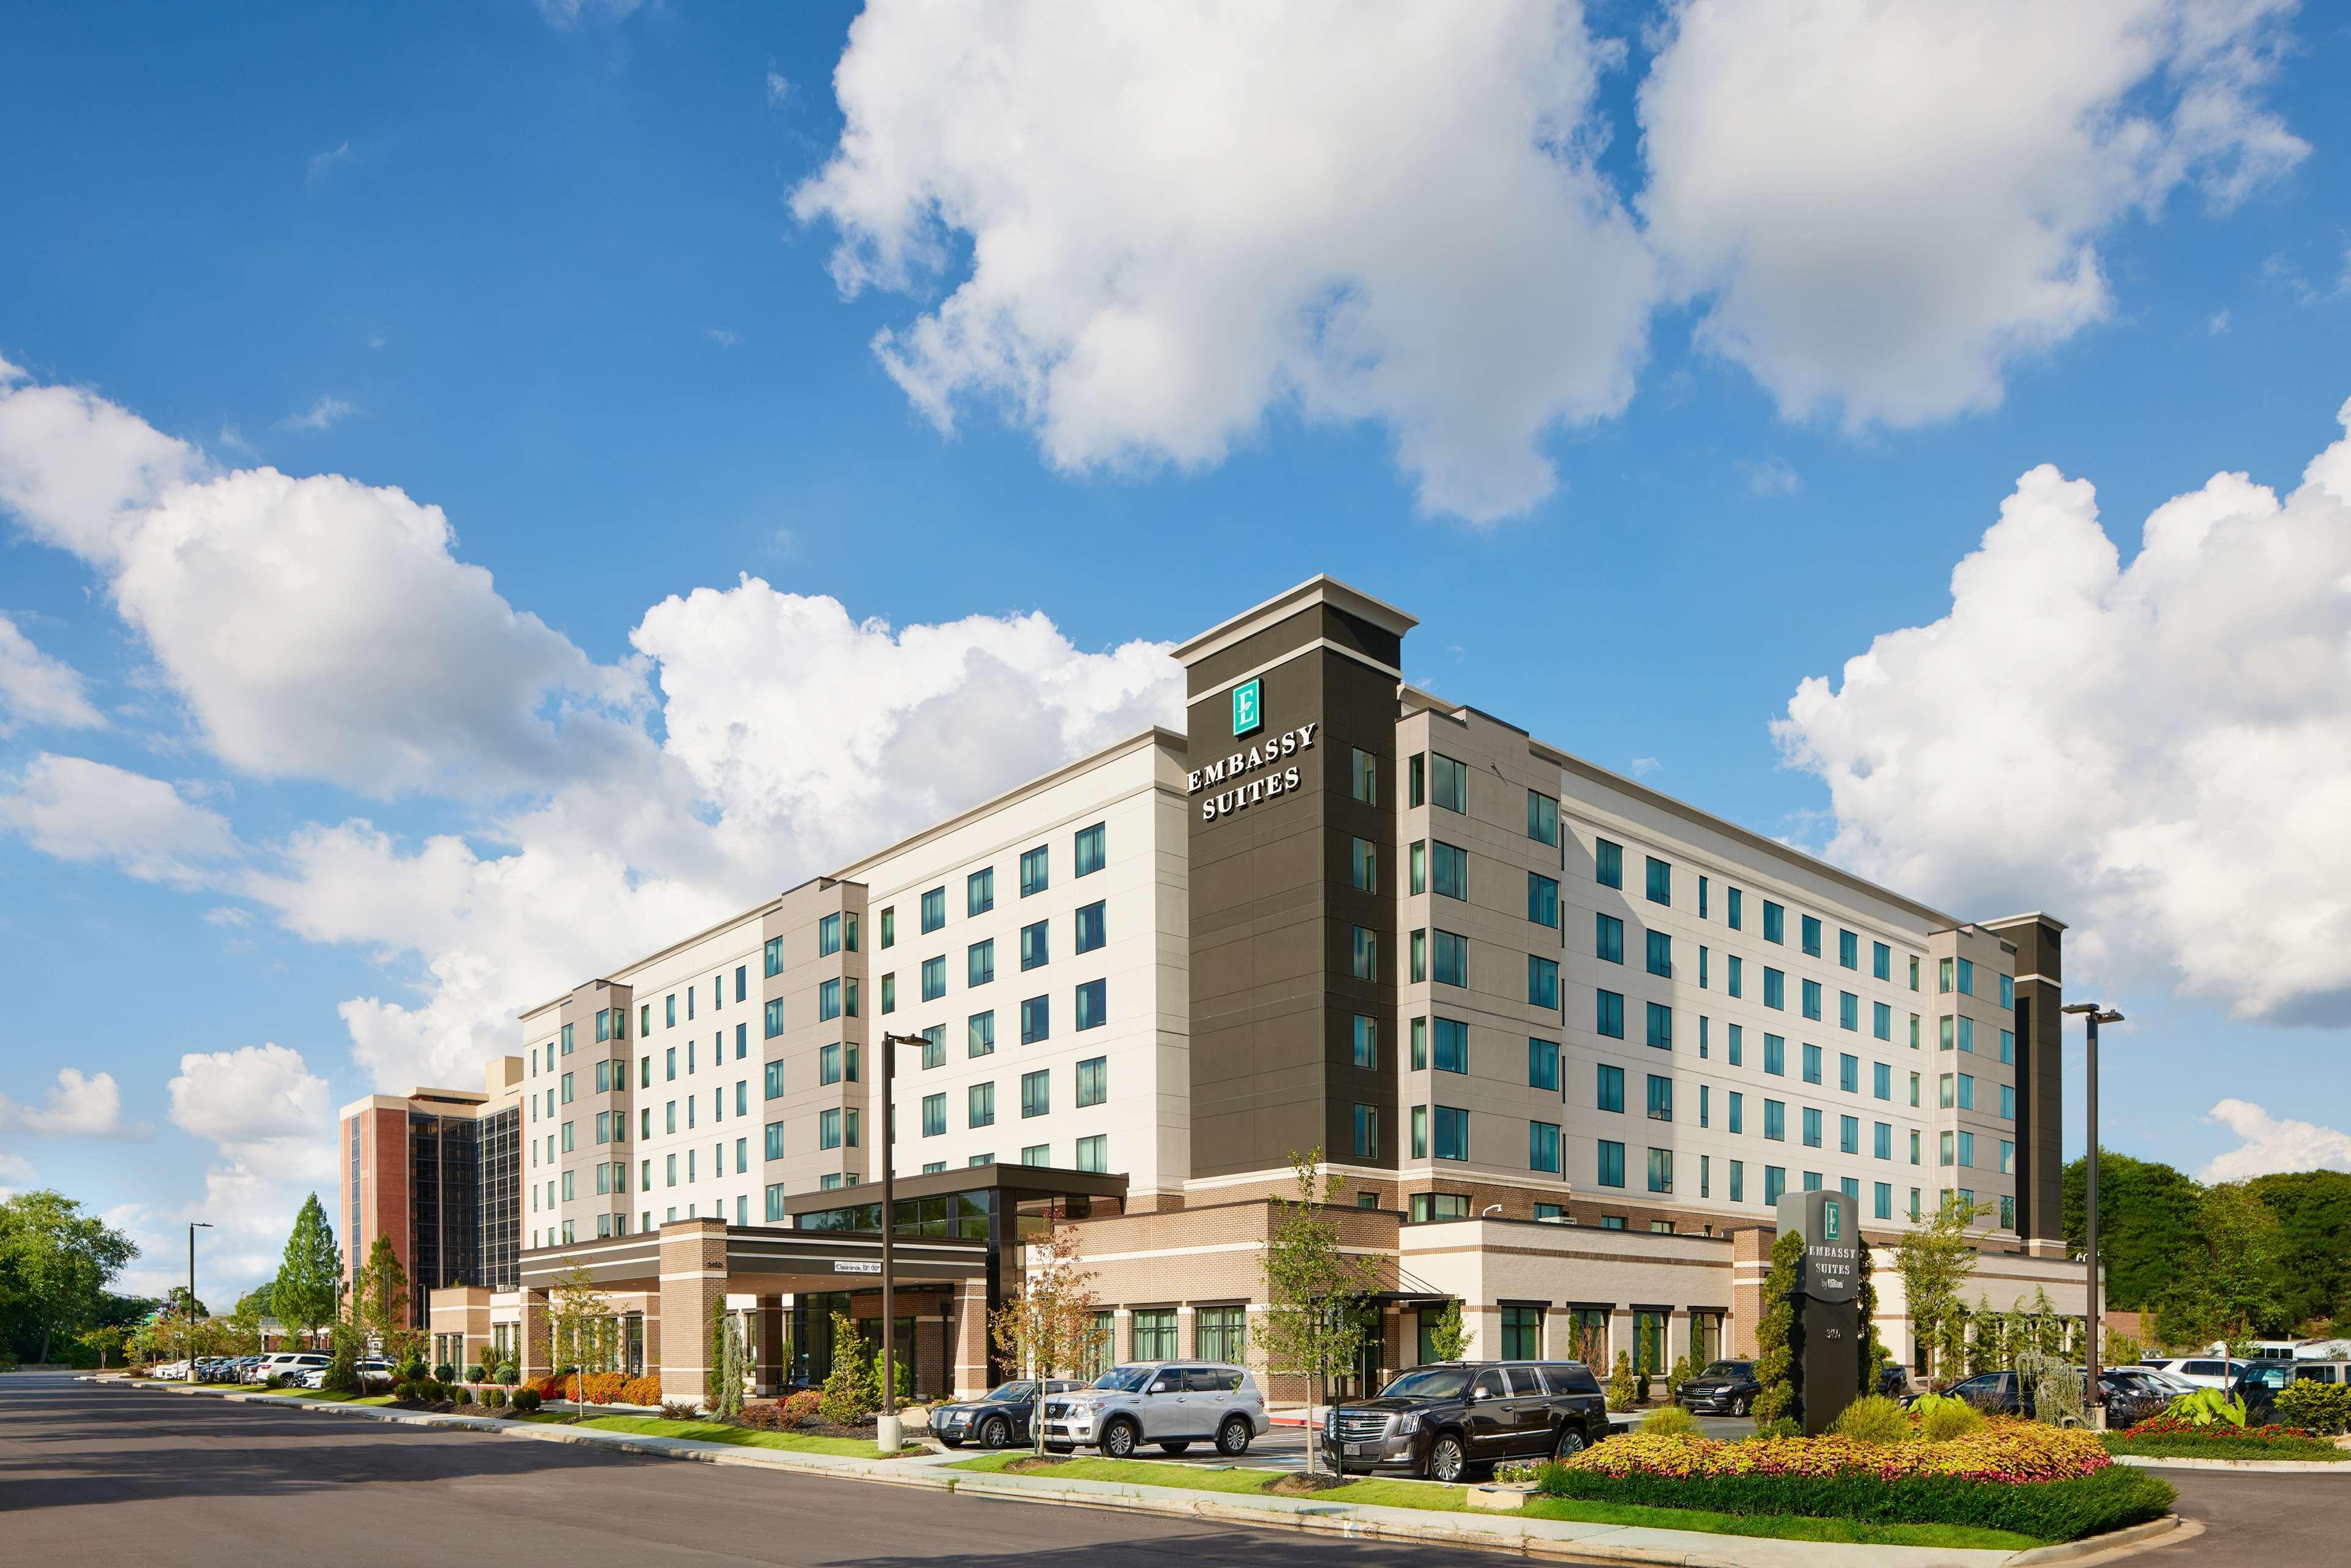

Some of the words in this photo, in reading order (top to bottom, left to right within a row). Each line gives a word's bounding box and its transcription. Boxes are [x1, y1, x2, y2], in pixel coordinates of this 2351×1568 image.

[1239, 689, 1254, 726] E
[1187, 722, 1316, 793] EMBASSY
[1203, 766, 1299, 820] SUITES
[1809, 1245, 1856, 1259] EMBASSY
[1815, 1262, 1850, 1275] SUITES
[1821, 1278, 1827, 1290] by
[1828, 1278, 1843, 1288] Hilton
